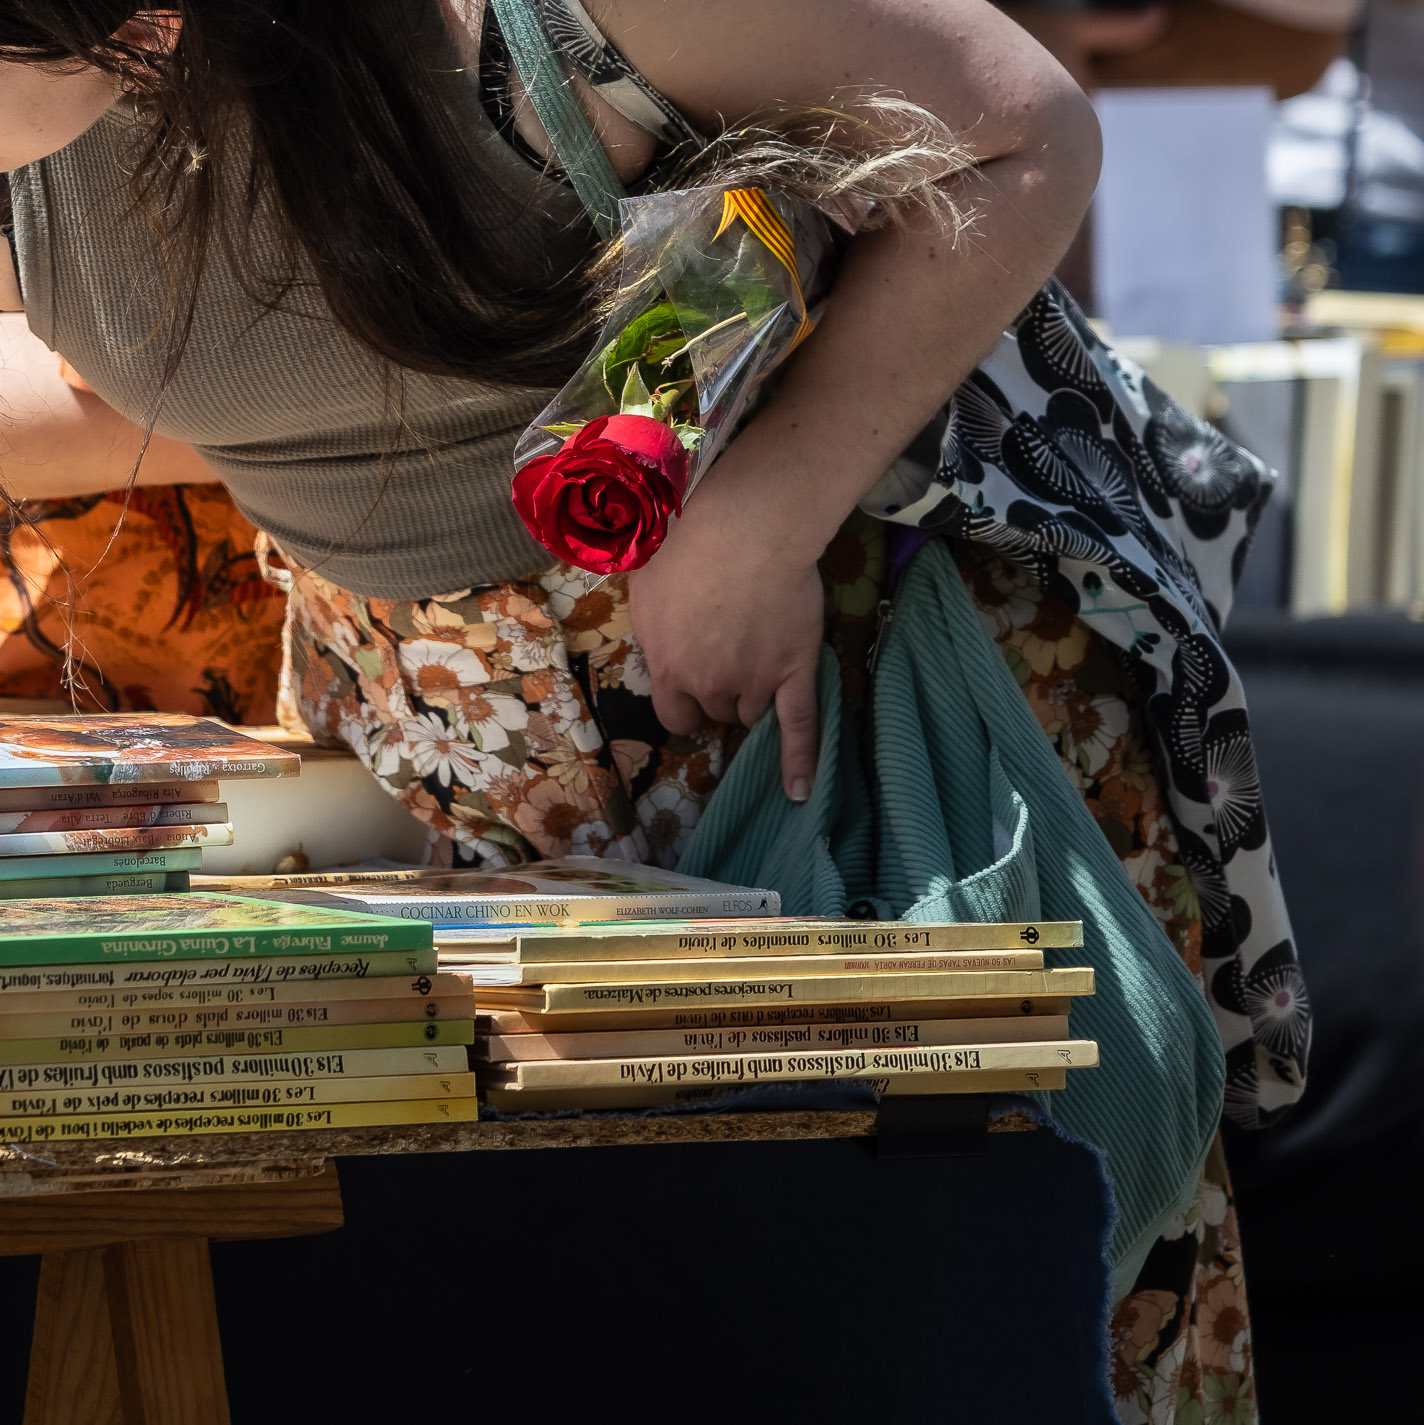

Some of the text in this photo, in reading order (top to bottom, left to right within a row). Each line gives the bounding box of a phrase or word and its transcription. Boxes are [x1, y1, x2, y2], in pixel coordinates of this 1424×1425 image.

[222, 762, 264, 773] Garrotxa
[51, 792, 82, 804] d'Aran
[86, 792, 101, 802] Val
[112, 786, 158, 801] Ribagorça
[163, 788, 181, 798] Alta
[61, 814, 81, 825] Alta
[86, 813, 111, 824] Terra
[159, 809, 191, 820] Ribera
[166, 832, 195, 843] Anoia
[113, 856, 165, 869] Barcelonès
[105, 875, 152, 891] Berguedà
[401, 905, 462, 920] COCINAR
[465, 904, 510, 919] CHINO
[515, 903, 533, 917] EN
[537, 903, 569, 917] WOK
[616, 906, 656, 916] ELIZABETH
[722, 899, 752, 912] ELFOS
[102, 938, 176, 957] Gironina
[180, 936, 230, 955] Cuina
[233, 936, 255, 953] La
[340, 932, 388, 949] Jaume
[721, 936, 736, 950] de
[742, 934, 809, 950] amanides
[818, 933, 866, 948] millors
[874, 933, 896, 948] 30
[904, 932, 930, 947] Les
[124, 968, 197, 986] elaborar
[200, 962, 229, 981] per
[277, 963, 296, 980] de
[300, 959, 369, 979] Receptes
[645, 988, 661, 1002] de
[665, 982, 712, 999] postres
[715, 981, 766, 999] mejores
[769, 982, 793, 998] Los
[232, 1057, 289, 1079] millors
[291, 1056, 314, 1077] 30
[316, 1054, 344, 1075] Els
[747, 1057, 782, 1078] amb
[787, 1052, 865, 1078] pastissos
[872, 1052, 928, 1073] millors
[930, 1051, 952, 1071] 30
[954, 1049, 980, 1070] Els
[17, 1067, 39, 1086] de
[43, 1064, 98, 1087] fruites
[103, 1063, 137, 1083] amb
[143, 1056, 224, 1083] pastissos
[667, 1062, 687, 1081] de
[691, 1058, 744, 1080] fruites
[156, 1117, 172, 1132] de
[174, 1112, 234, 1132] receptes
[237, 1112, 284, 1129] millors
[286, 1111, 303, 1127] 30
[306, 1109, 332, 1125] Les
[102, 1119, 152, 1136] vedella
